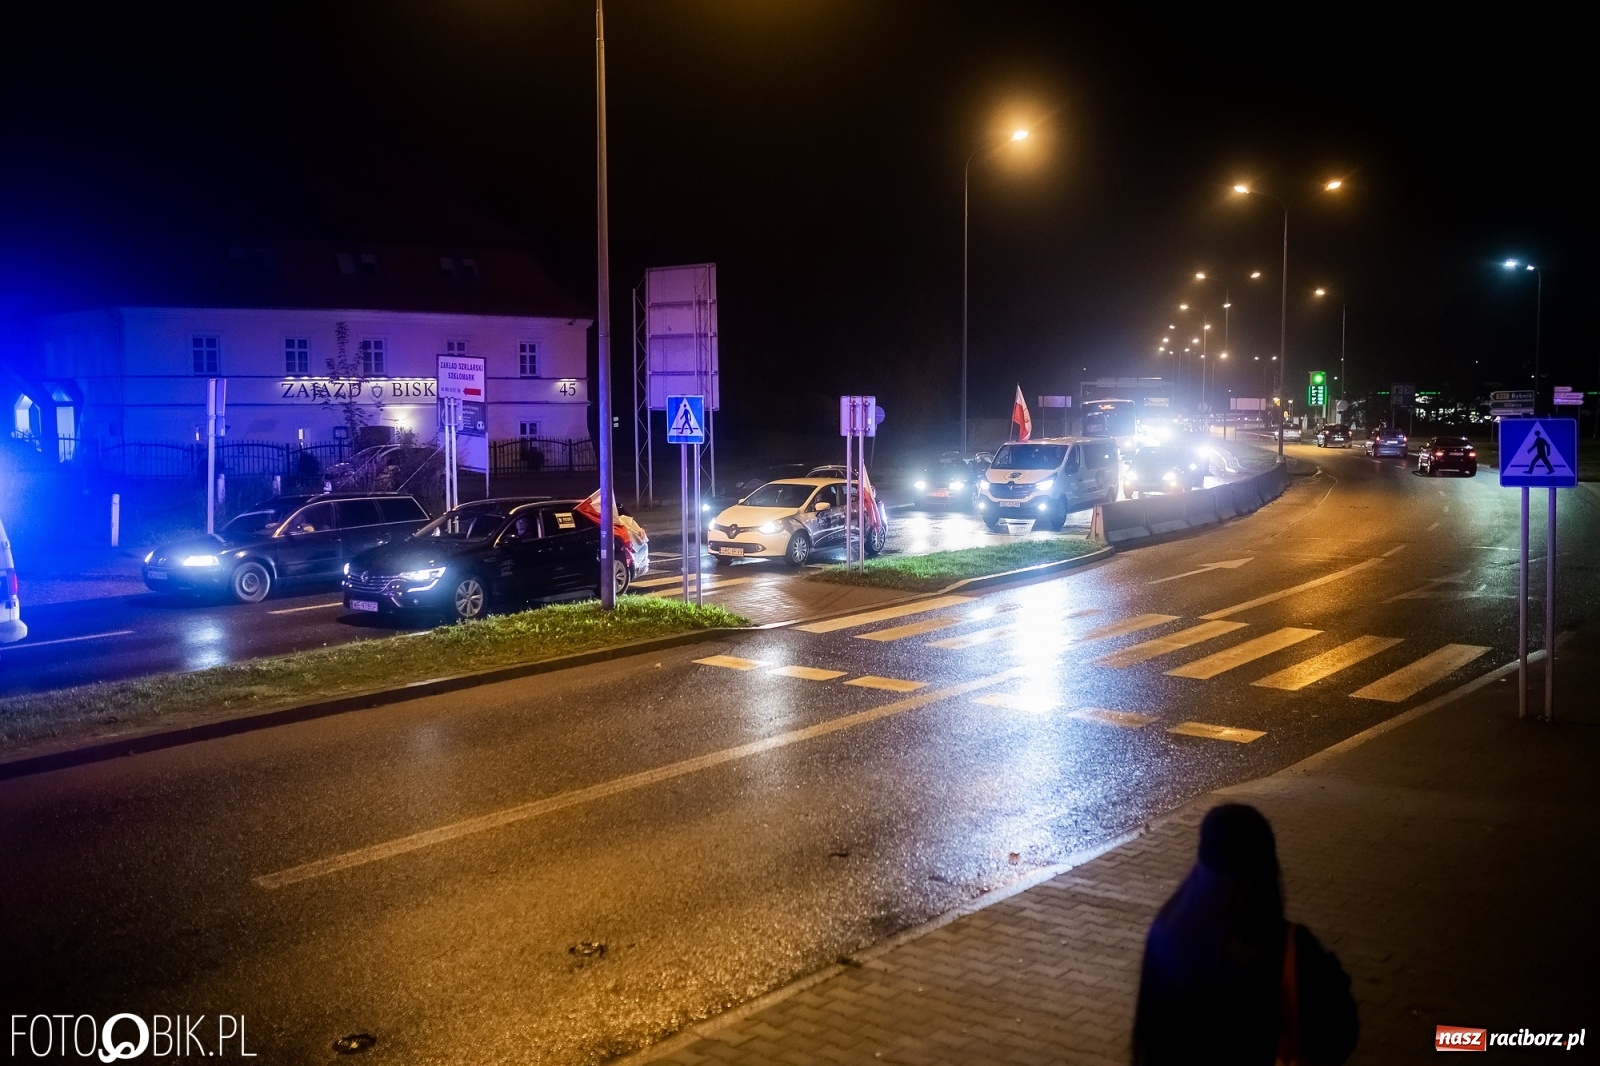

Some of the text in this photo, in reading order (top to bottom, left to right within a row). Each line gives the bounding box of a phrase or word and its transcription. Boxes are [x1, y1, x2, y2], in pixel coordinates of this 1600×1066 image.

[440, 361, 484, 372] ZAKŁAD SZKLARSKI
[281, 382, 362, 402] ZAJAZD
[559, 382, 576, 397] 45
[1511, 392, 1533, 400] Rybnik
